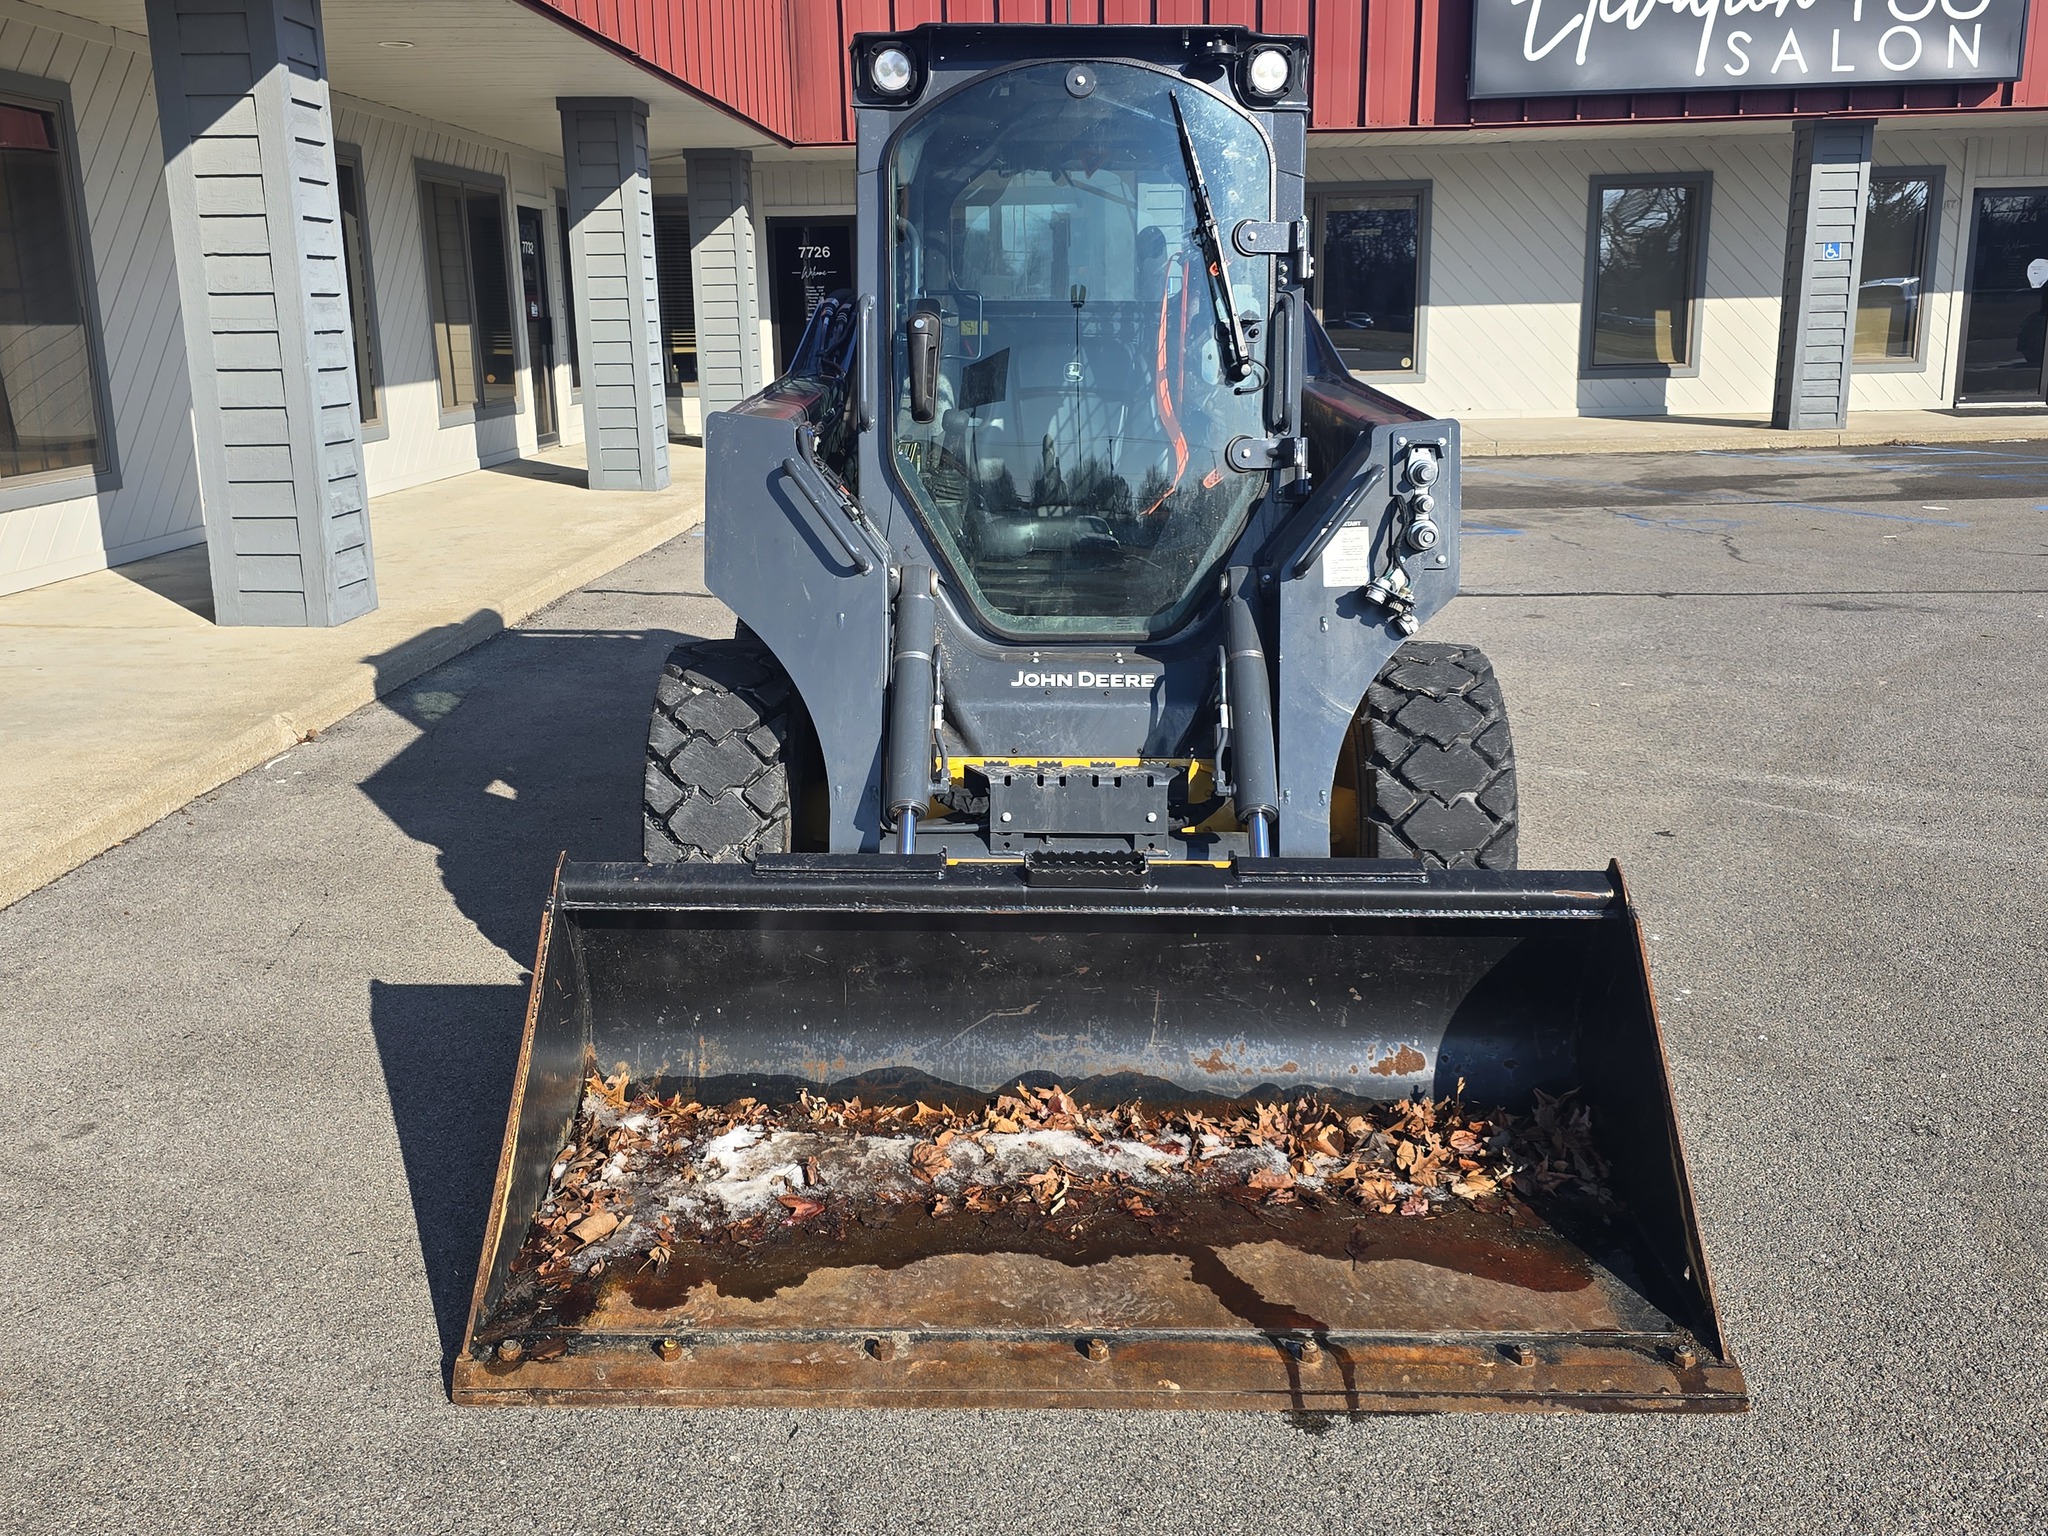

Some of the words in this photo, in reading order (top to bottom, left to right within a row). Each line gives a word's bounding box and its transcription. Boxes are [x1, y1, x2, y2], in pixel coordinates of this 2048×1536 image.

[1723, 23, 1982, 77] SALON
[798, 246, 831, 258] 7726
[1010, 670, 1073, 687] JOHN
[1078, 671, 1156, 688] DEERE
